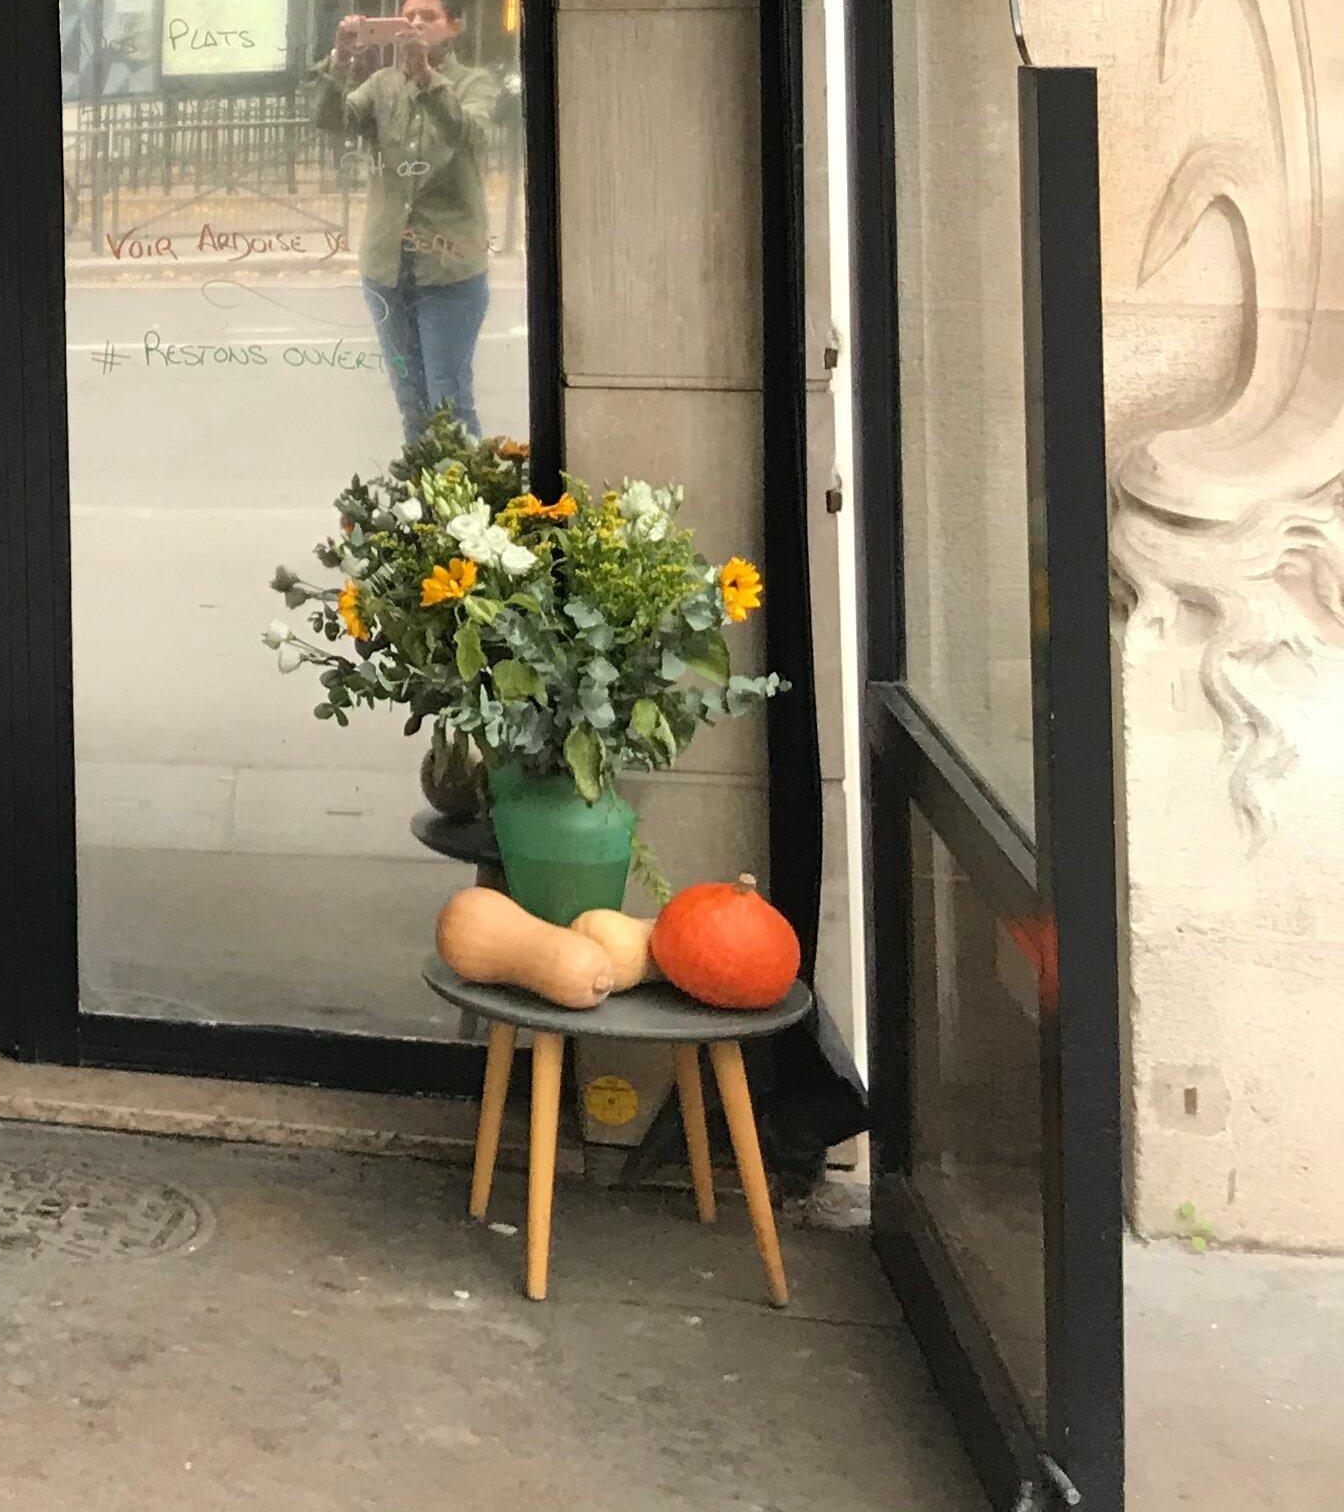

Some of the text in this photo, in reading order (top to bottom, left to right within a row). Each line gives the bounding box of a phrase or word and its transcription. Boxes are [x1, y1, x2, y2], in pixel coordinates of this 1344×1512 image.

[169, 18, 256, 52] PLATS
[105, 227, 179, 261] VOIR
[196, 223, 307, 261] ARDOISE
[143, 330, 268, 368] RESTONS
[283, 337, 408, 380] OUVERTS
